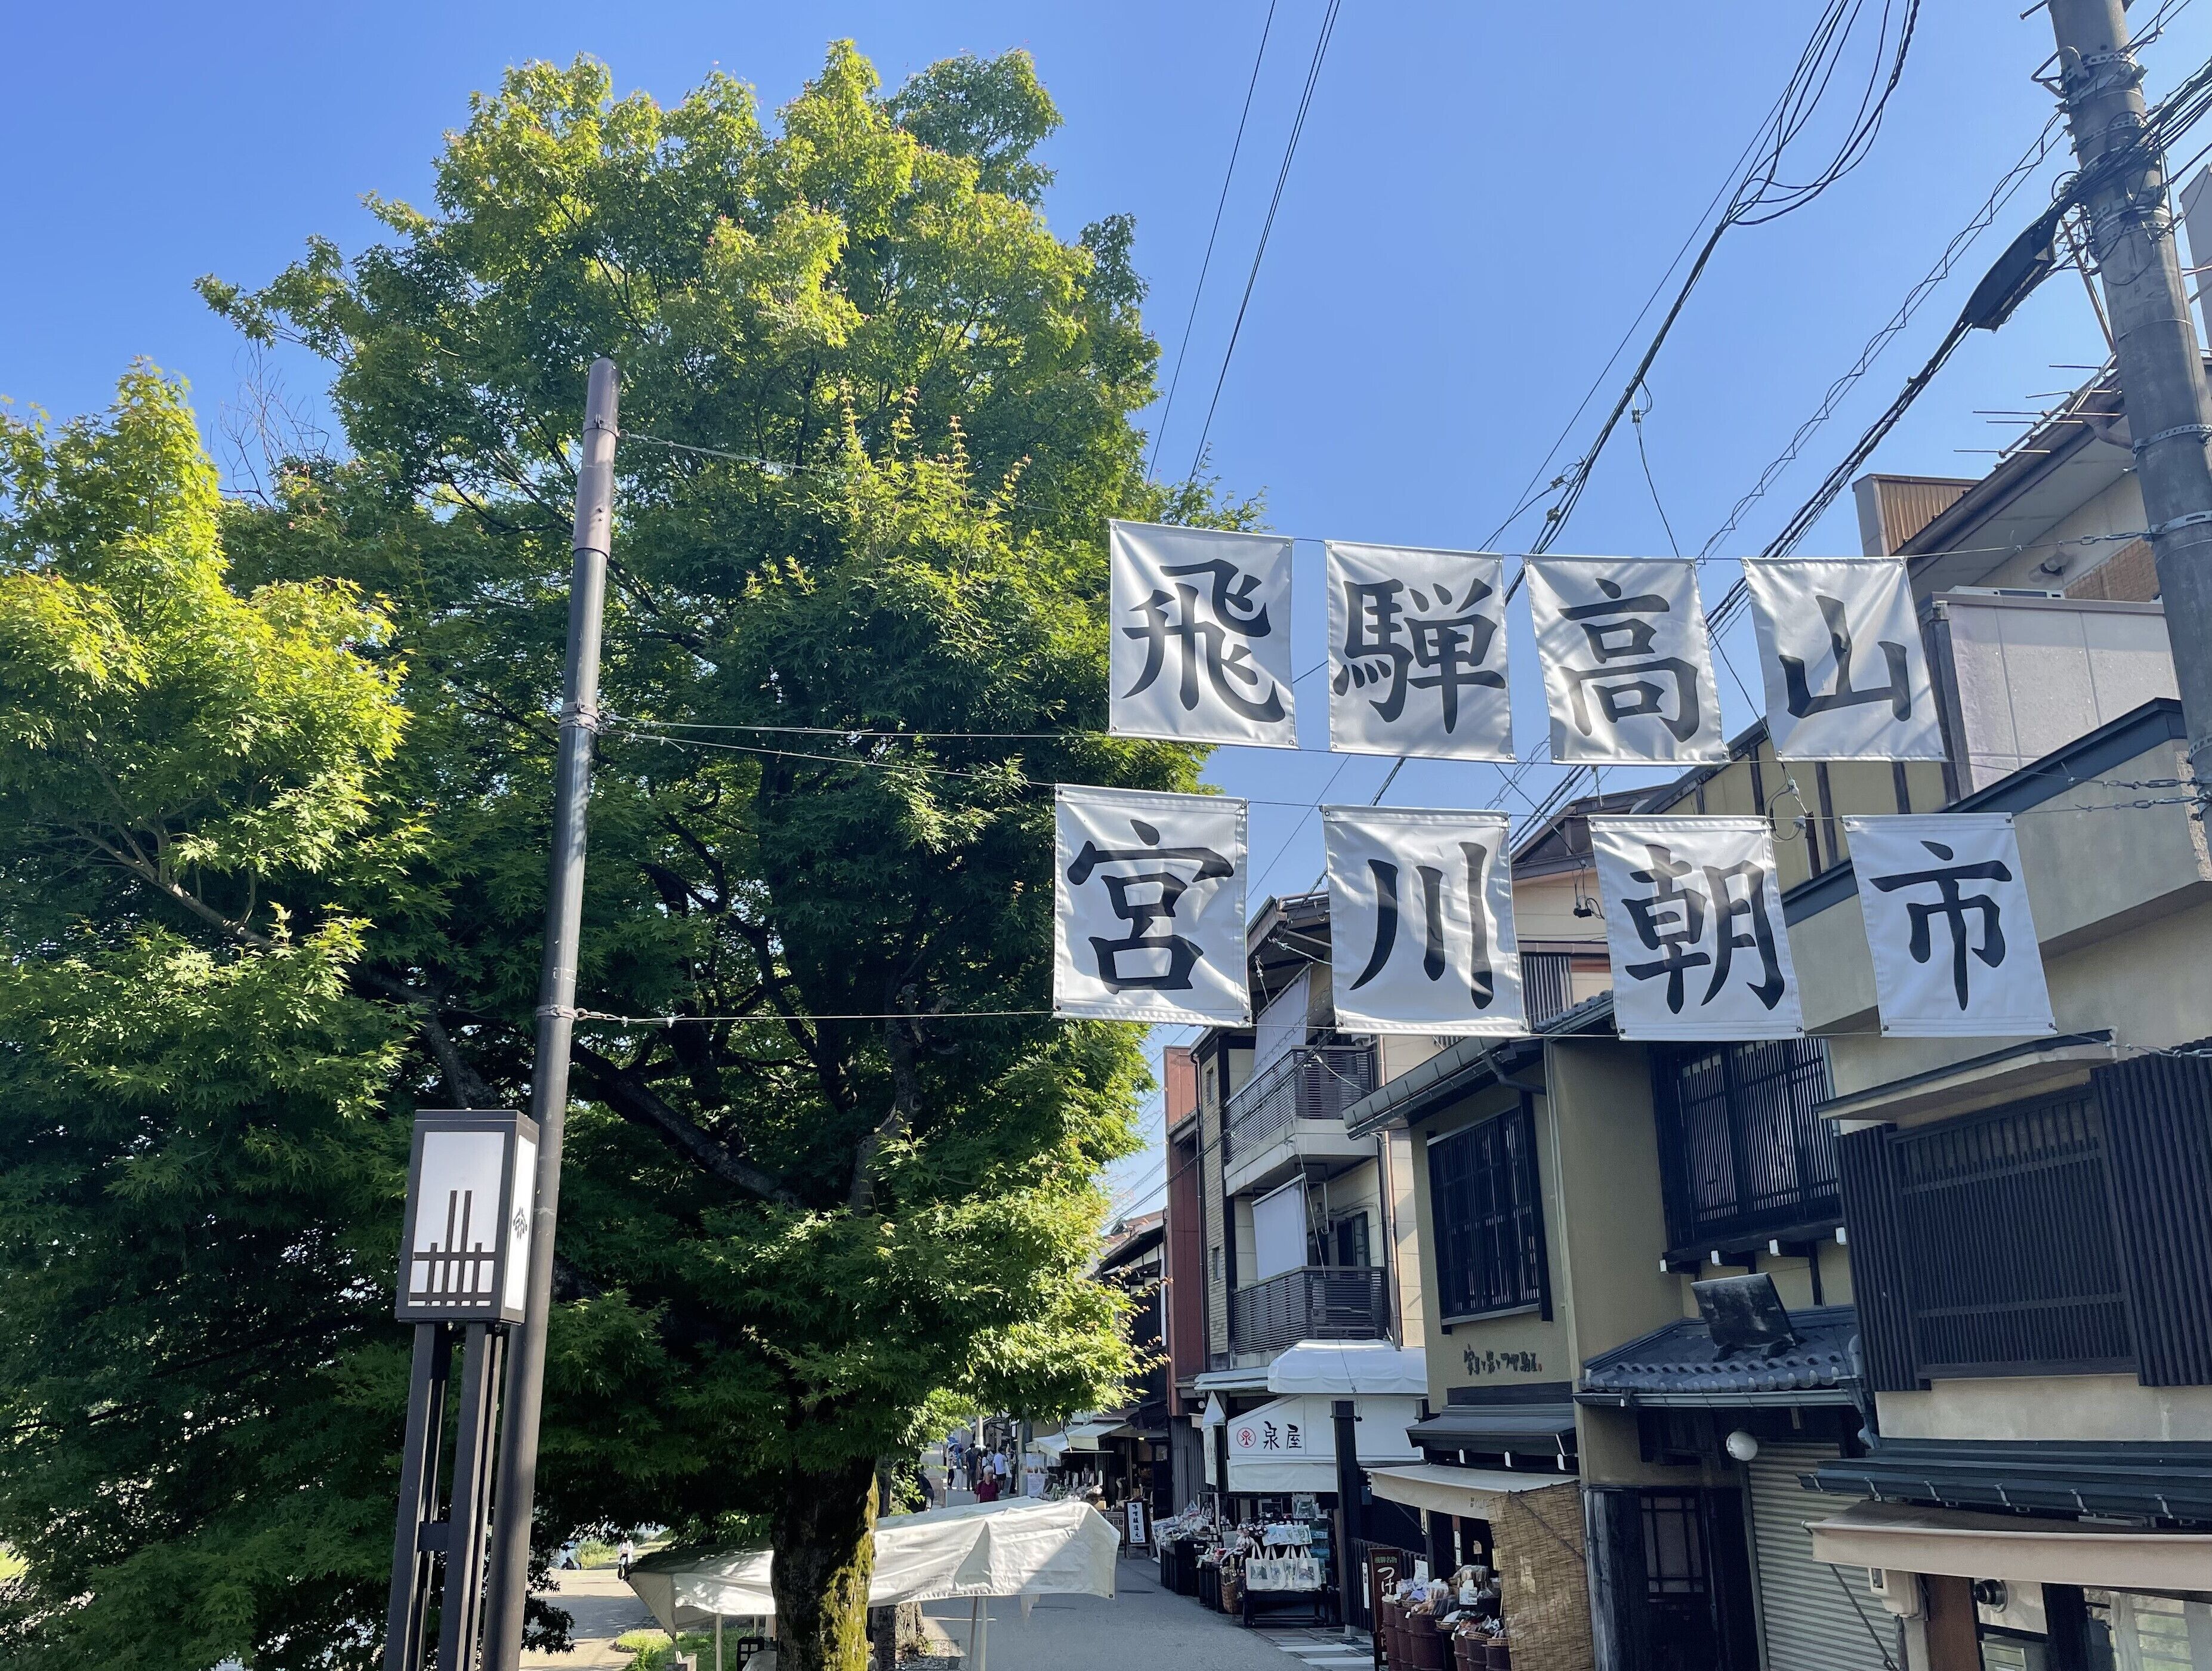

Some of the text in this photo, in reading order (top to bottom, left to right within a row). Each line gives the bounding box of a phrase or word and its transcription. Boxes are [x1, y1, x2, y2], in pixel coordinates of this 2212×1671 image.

[1122, 558, 1910, 743] 飛騨高山
[1067, 819, 2012, 1014] 宮川朝市
[1263, 1420, 1303, 1450] 泉屋
